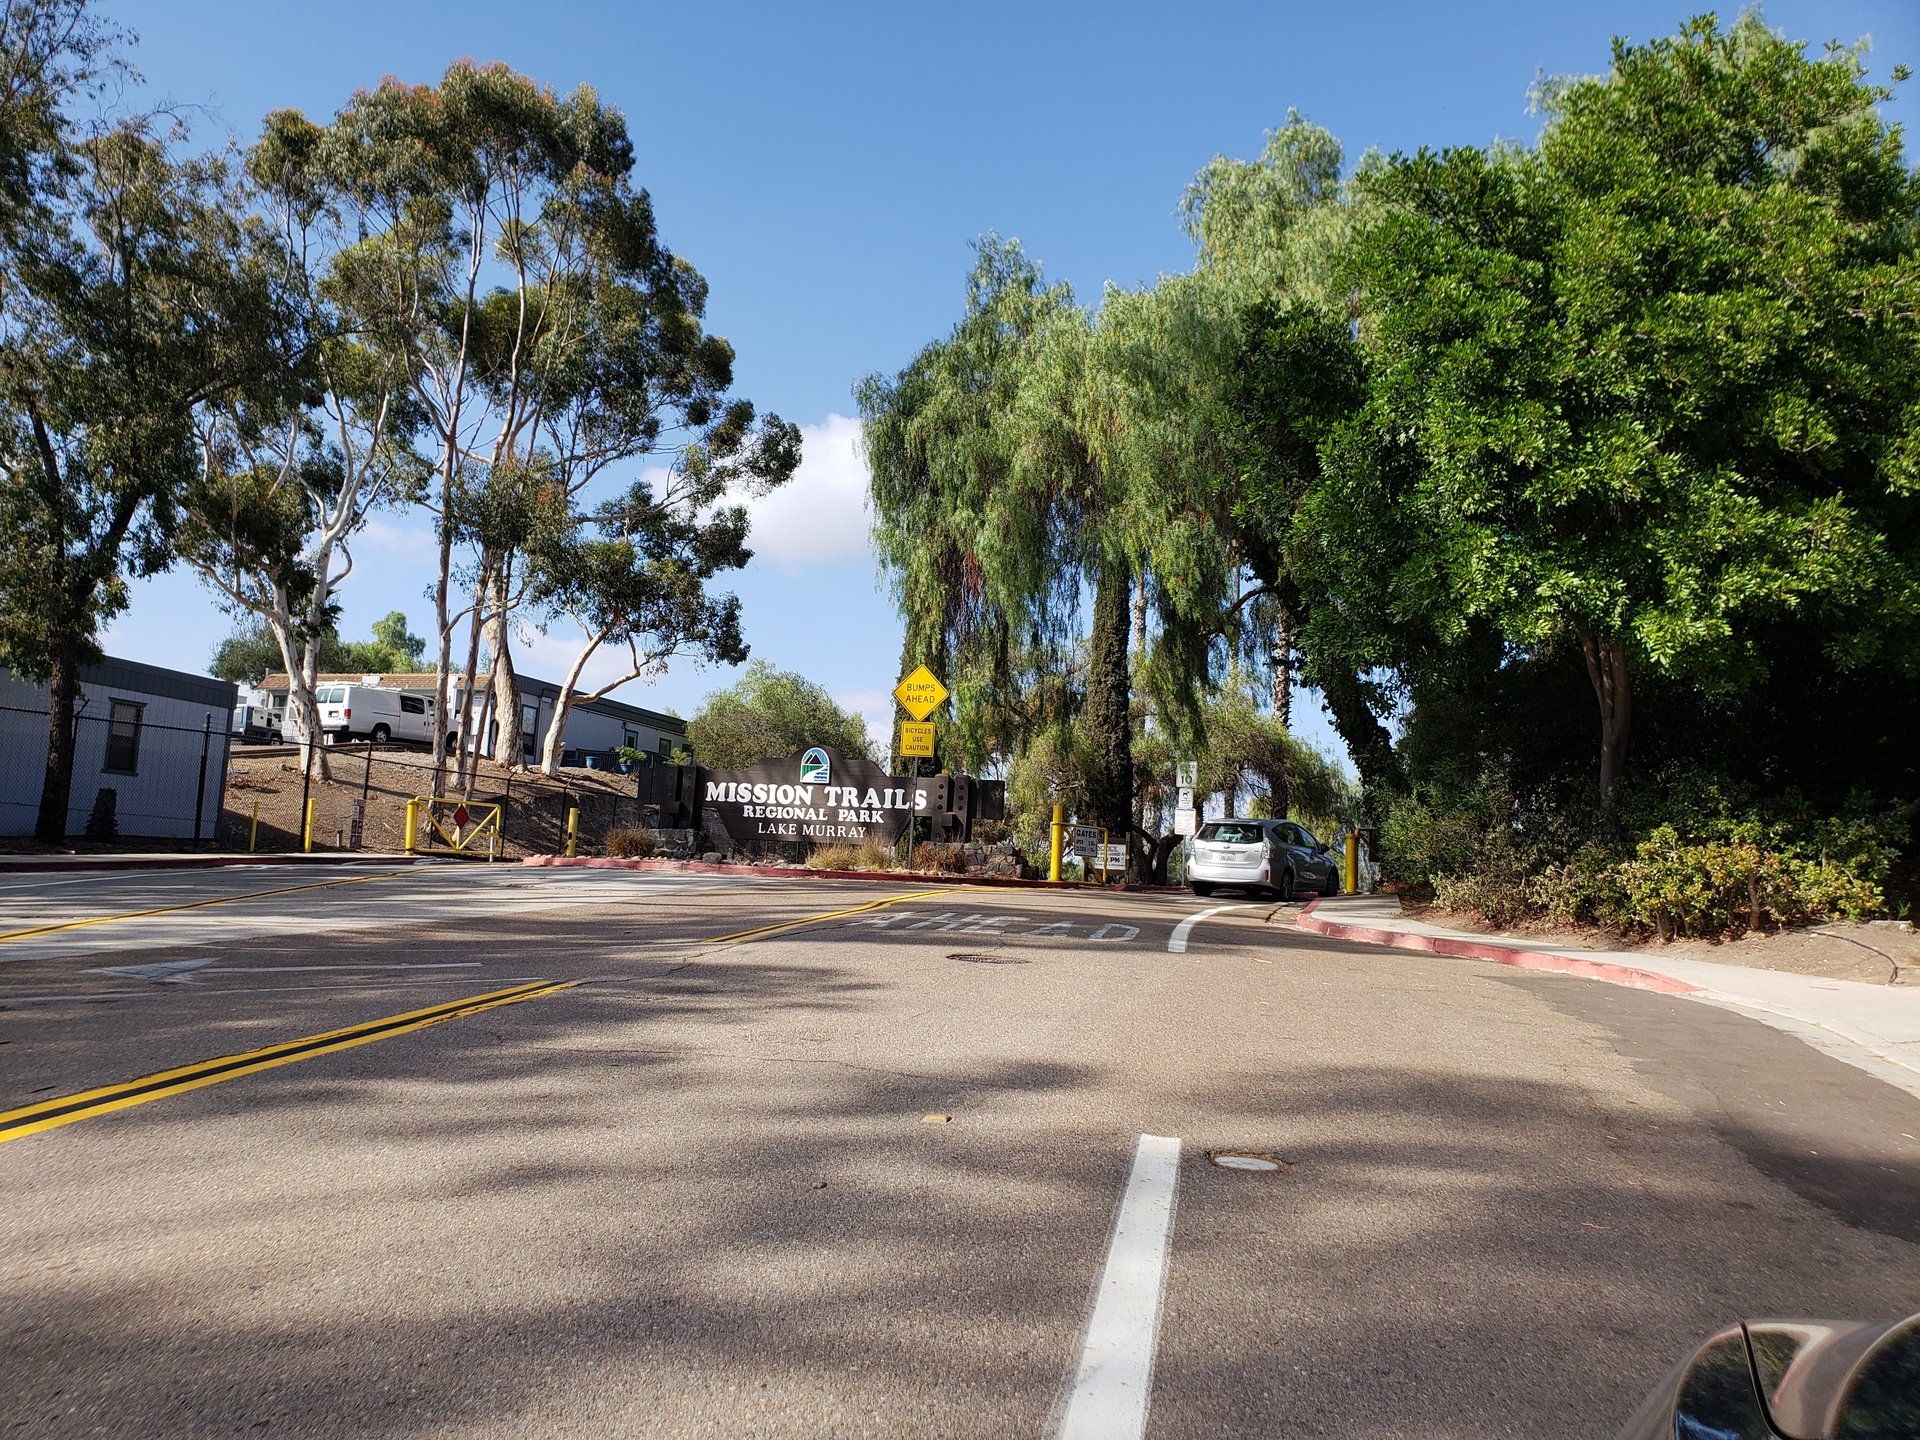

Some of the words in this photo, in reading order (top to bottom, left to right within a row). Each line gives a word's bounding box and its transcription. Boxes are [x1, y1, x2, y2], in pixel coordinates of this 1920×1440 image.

[906, 683, 936, 692] BUMPS
[905, 695, 935, 704] AHEAD
[905, 727, 932, 735] BICYCLES
[905, 744, 930, 752] CAUTION
[1181, 774, 1193, 785] 10
[705, 781, 814, 806] MISSION
[824, 786, 928, 810] TRAILS
[742, 805, 828, 821] REGIONAL
[837, 809, 885, 824] PARK
[757, 822, 797, 836] LAKE
[802, 824, 867, 839] MURRAY
[1076, 829, 1097, 839] GATES
[845, 911, 1140, 942] AHEAD
